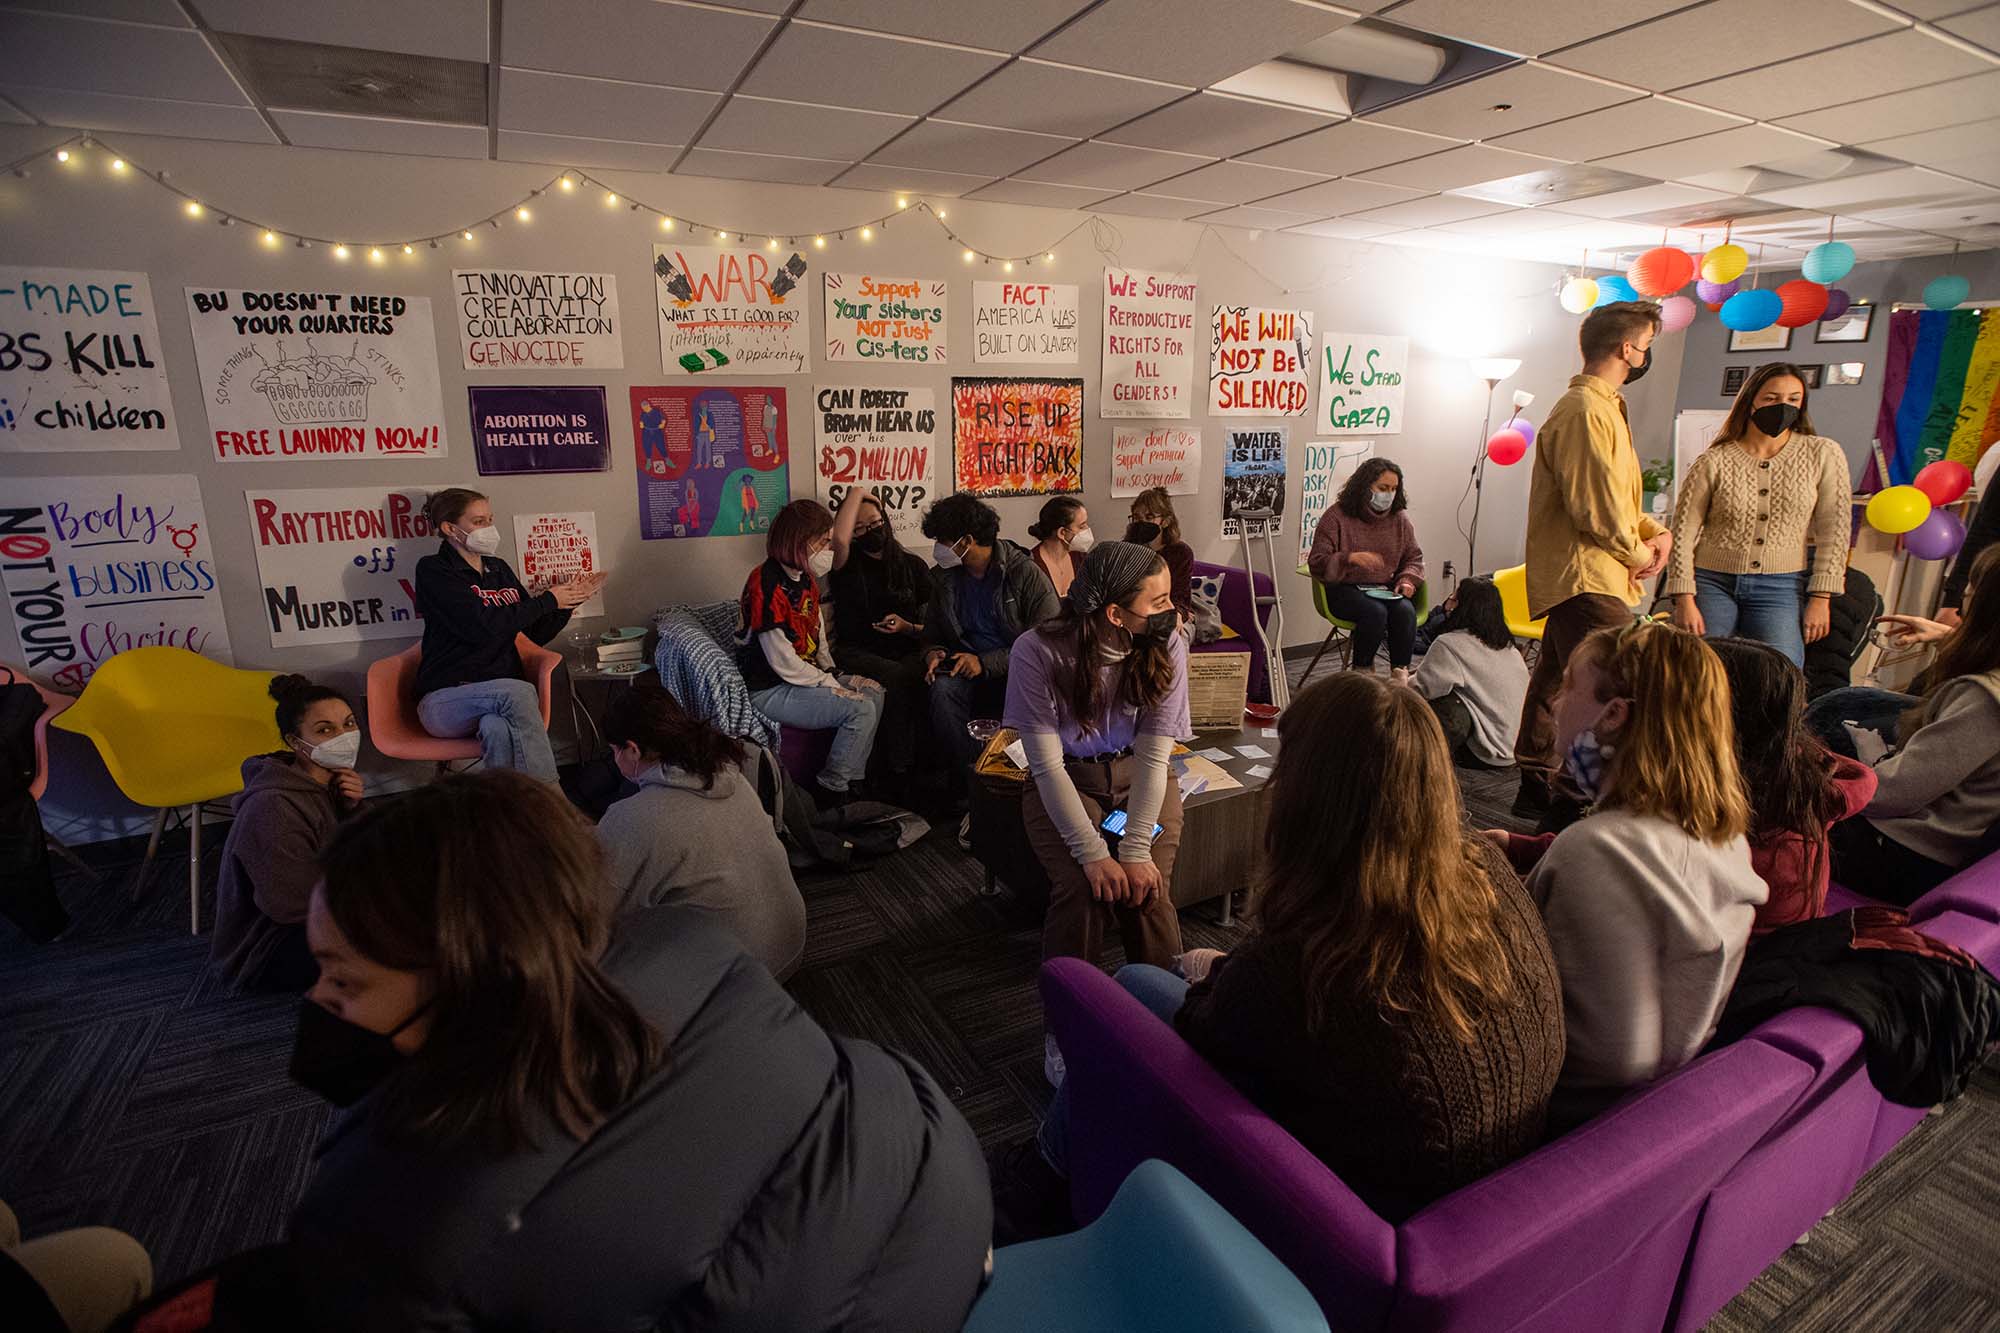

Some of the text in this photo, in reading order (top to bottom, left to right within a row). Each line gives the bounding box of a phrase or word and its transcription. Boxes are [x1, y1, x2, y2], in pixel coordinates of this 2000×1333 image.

[458, 272, 604, 299] INNOVATION
[675, 250, 775, 304] WAR
[858, 276, 921, 302] Support
[1108, 273, 1196, 301] WE SUPPORT
[192, 290, 406, 316] BU DOESN'T NEED
[464, 297, 607, 319] CREATIVITY
[661, 307, 800, 323] WHAT IS IT GOOD FOR?
[833, 298, 942, 323] Your sisters
[232, 314, 394, 336] YOUR QUARTERS
[467, 317, 612, 338] COLLABORATION
[976, 307, 1077, 326] AMERICA WAS
[1108, 304, 1192, 329] REPRODUCTIVE
[1221, 311, 1250, 343] WE
[856, 320, 933, 341] NOT Just
[64, 330, 155, 376] KILL
[470, 341, 585, 364] GENOCIDE
[856, 338, 929, 362] Cis-ters
[979, 332, 1078, 357] BUILT ON SLAVERY
[1109, 335, 1183, 356] RIGHTS FOR
[1135, 360, 1160, 378] ALL
[1220, 348, 1297, 373] NOT BE
[1325, 344, 1354, 385] We
[817, 388, 909, 413] CAN ROBERT
[1113, 383, 1178, 401] GENDERS!
[1218, 378, 1307, 411] SILENCED
[34, 399, 166, 431] children
[484, 414, 588, 429] ABORTION IS
[824, 409, 936, 434] BROWN HEAR US
[976, 401, 1070, 428] RISE UP
[1329, 395, 1391, 429] GAZA
[216, 425, 440, 458] FREE LAUNDRY NOW!
[486, 431, 600, 447] HEALTH CARE.
[868, 432, 886, 443] his
[1232, 431, 1281, 449] WATER
[820, 444, 857, 483] $2
[858, 445, 928, 482] MILLION
[977, 441, 1077, 477] FIGHT BACK
[1232, 448, 1281, 462] IS LIFE
[828, 485, 927, 512] SRY?
[48, 493, 175, 544] Body
[254, 498, 388, 546] RAYTHEON
[1303, 512, 1320, 530] fo
[527, 536, 589, 550] REVOLUTIONS
[353, 546, 396, 574] off
[68, 559, 215, 598] business
[265, 585, 386, 633] MURDER
[391, 606, 410, 622] in
[10, 581, 77, 668] YOUR
